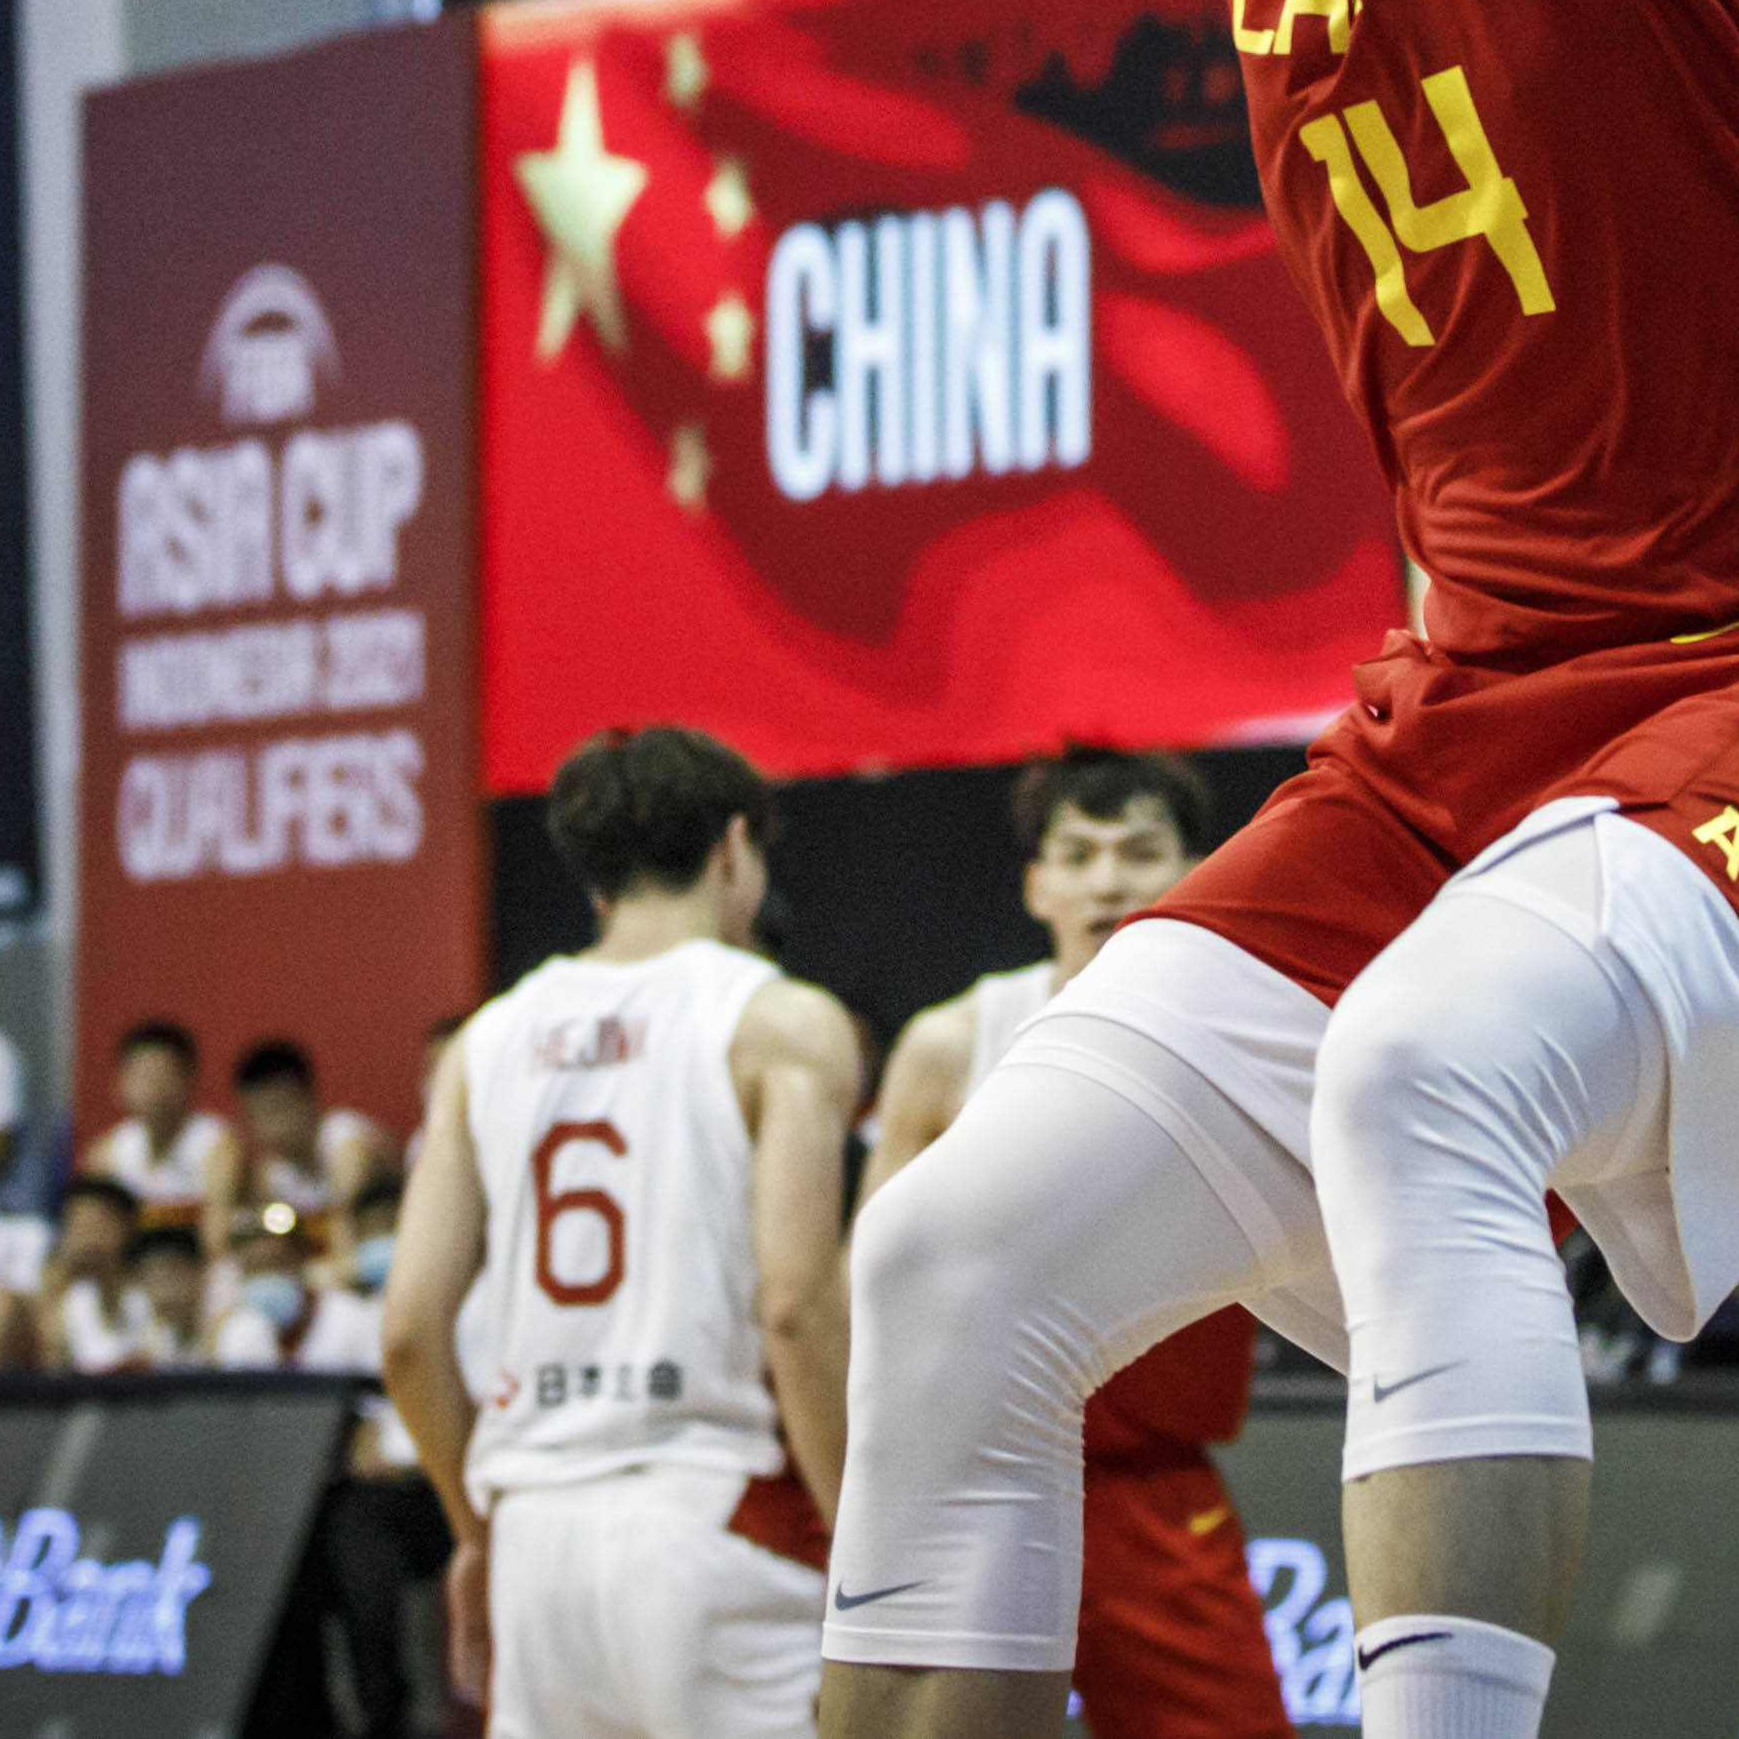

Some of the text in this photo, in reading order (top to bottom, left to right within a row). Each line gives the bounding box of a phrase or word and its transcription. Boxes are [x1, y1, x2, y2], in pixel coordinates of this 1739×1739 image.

[1300, 67, 1555, 346] 14
[765, 188, 1091, 501] CHINA
[117, 421, 423, 616] ASIA CUP
[117, 731, 424, 883] QUALIFIERS
[532, 1122, 627, 1306] 6
